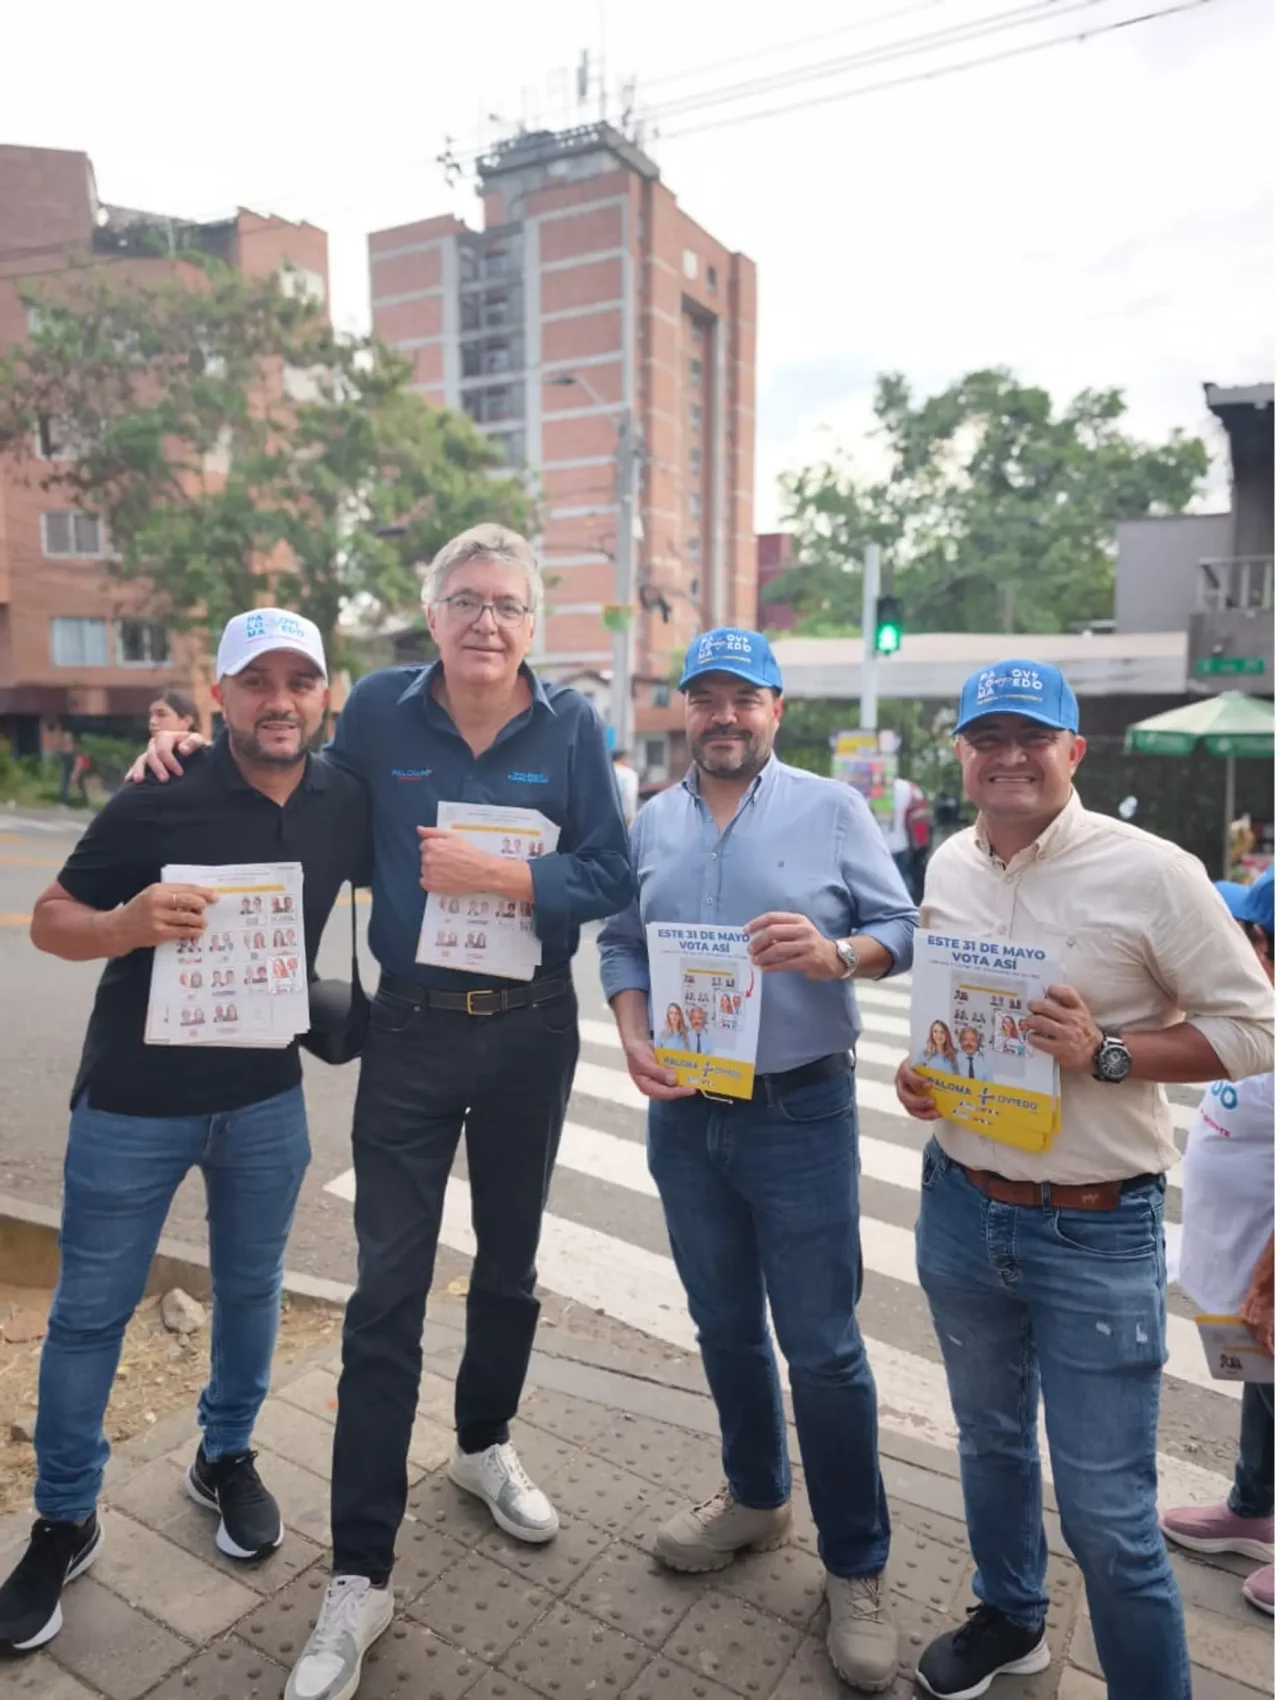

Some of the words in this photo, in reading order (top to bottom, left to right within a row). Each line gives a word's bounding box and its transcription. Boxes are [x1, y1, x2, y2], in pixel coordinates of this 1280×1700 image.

[1012, 679, 1043, 690] EDO
[658, 929, 684, 938] ESTE
[687, 931, 697, 939] 31
[701, 931, 715, 940] DE
[718, 932, 750, 943] MAYO
[679, 941, 709, 951] VOTA
[712, 943, 730, 953] ASÍ
[928, 935, 960, 949] ESTE
[963, 940, 976, 951] 31
[980, 942, 999, 955] DE
[1003, 946, 1045, 960] MAYO
[952, 952, 989, 966] VOTA
[993, 958, 1016, 970] ASÍ
